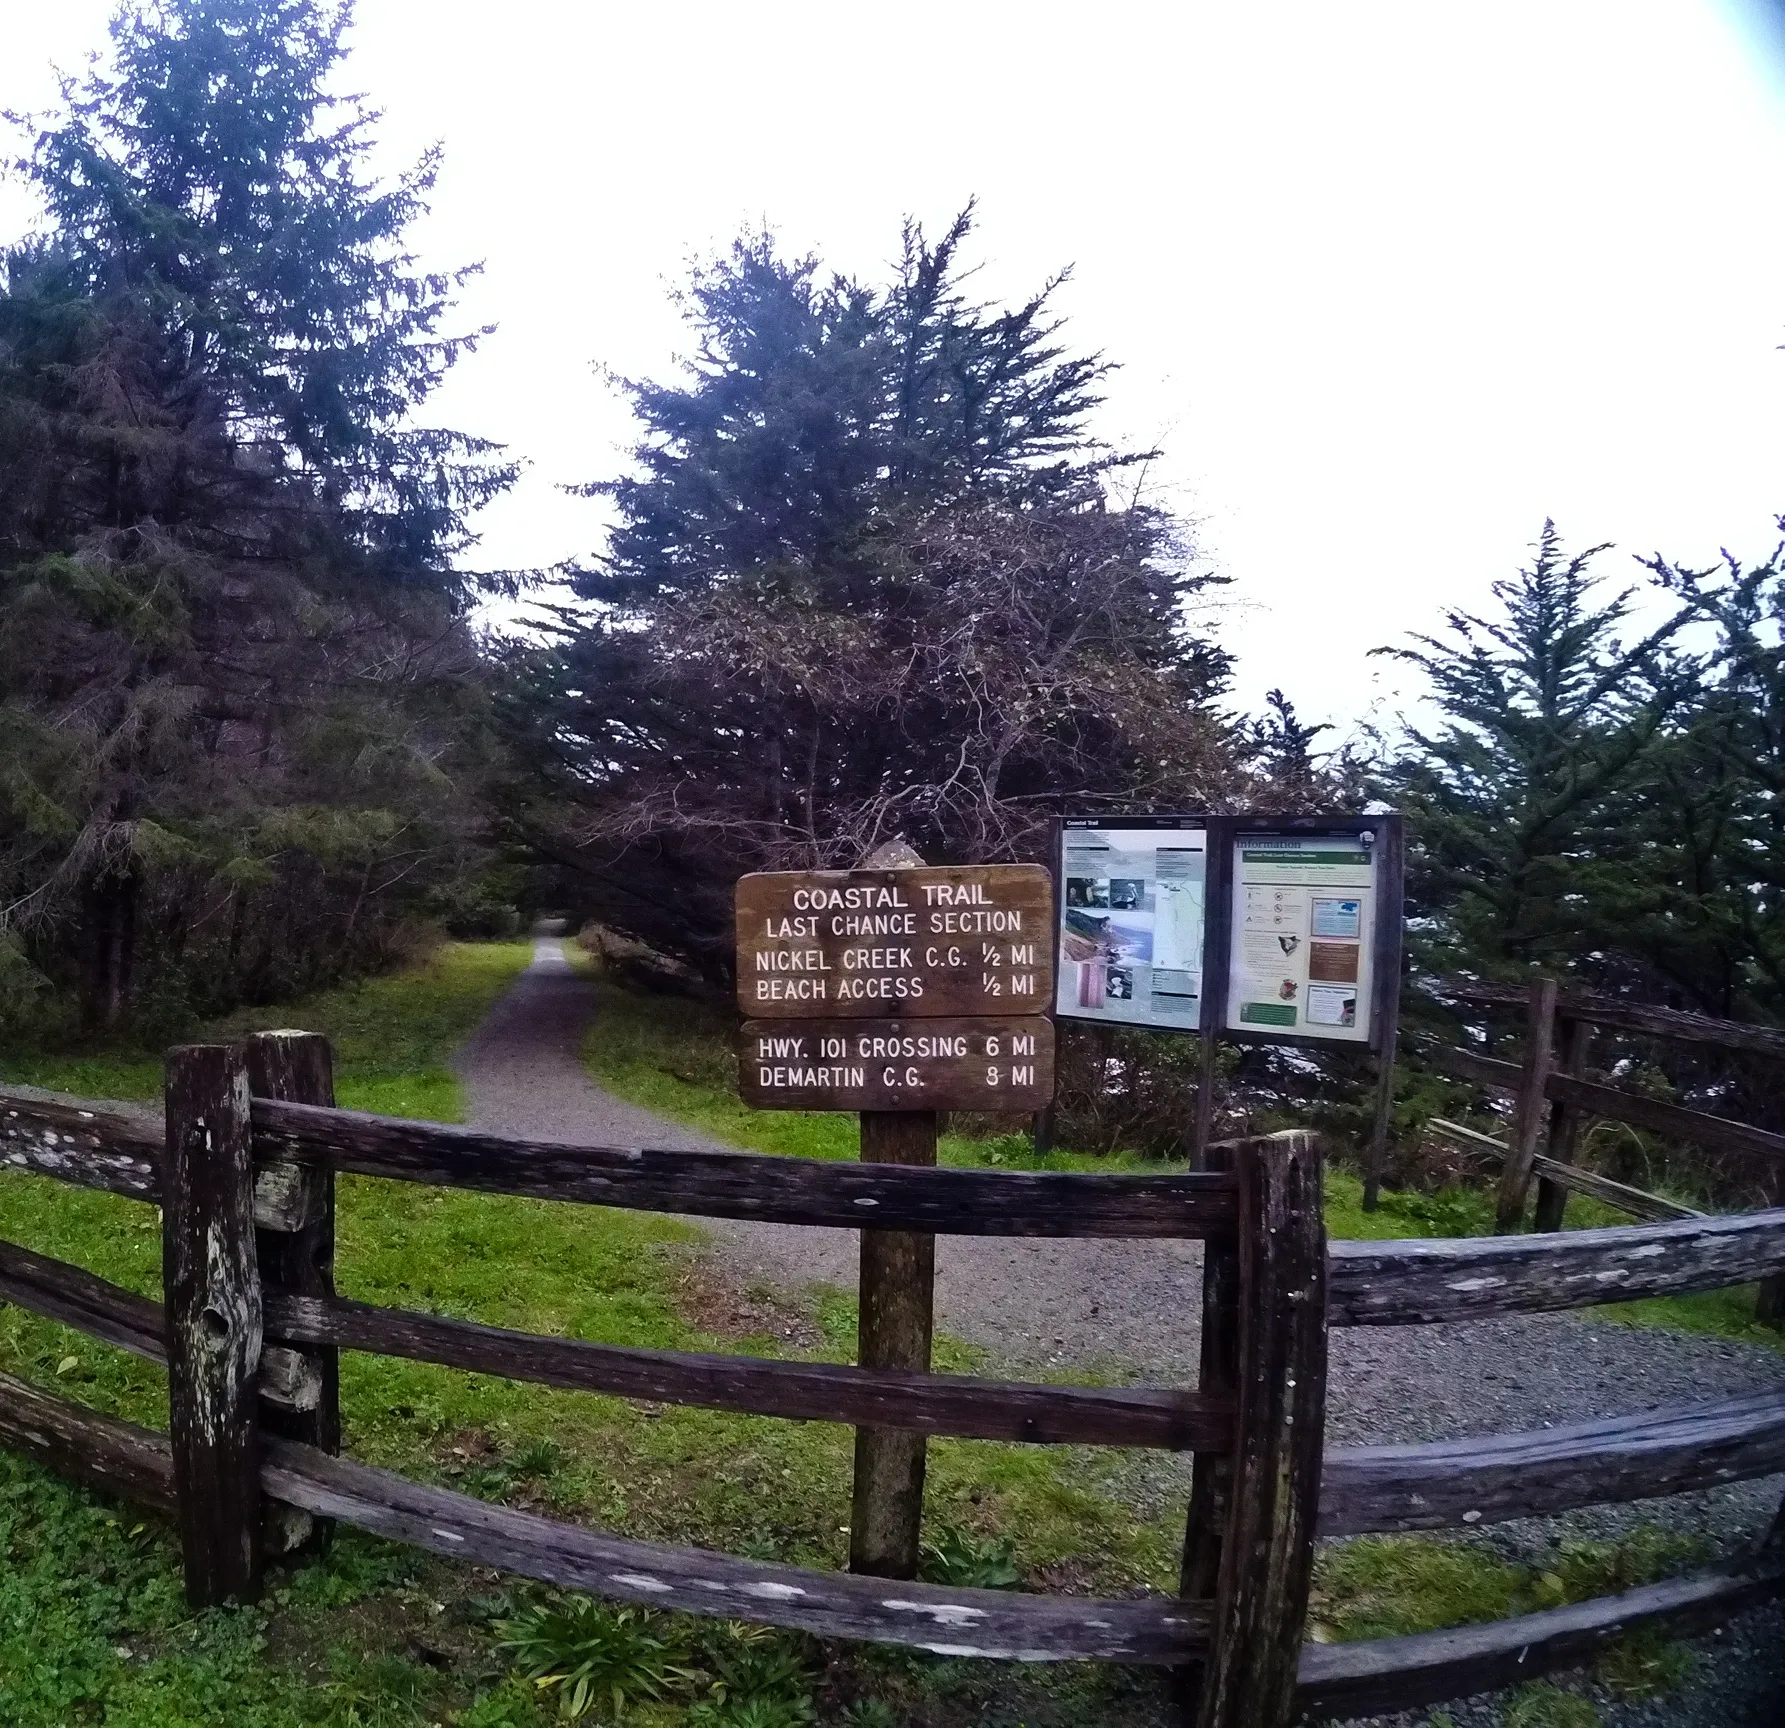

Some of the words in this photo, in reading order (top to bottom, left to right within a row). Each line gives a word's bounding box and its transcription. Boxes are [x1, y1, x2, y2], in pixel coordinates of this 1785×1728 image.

[1236, 840, 1301, 849] Information
[794, 887, 908, 910] COASTAL
[921, 884, 993, 906] TRAIL
[767, 917, 817, 937] LAST
[832, 914, 916, 935] CHANCE
[931, 911, 1020, 933] SECTION
[757, 950, 831, 970] NICKEL
[843, 948, 912, 969] CREEK
[926, 947, 966, 966] C.G.
[1012, 945, 1033, 964] MI
[757, 980, 825, 999] BEACH
[838, 977, 923, 999] ACCESS
[1012, 975, 1033, 994] MI
[760, 1039, 808, 1058] HWY.
[821, 1039, 846, 1057] 101
[859, 1037, 966, 1057] CROSSING
[986, 1036, 999, 1056] 6
[1013, 1036, 1034, 1055] MI
[761, 1067, 863, 1086] DEMARTIN
[884, 1067, 924, 1086] C.G.
[986, 1067, 1000, 1085] 8
[1013, 1066, 1033, 1085] MI
